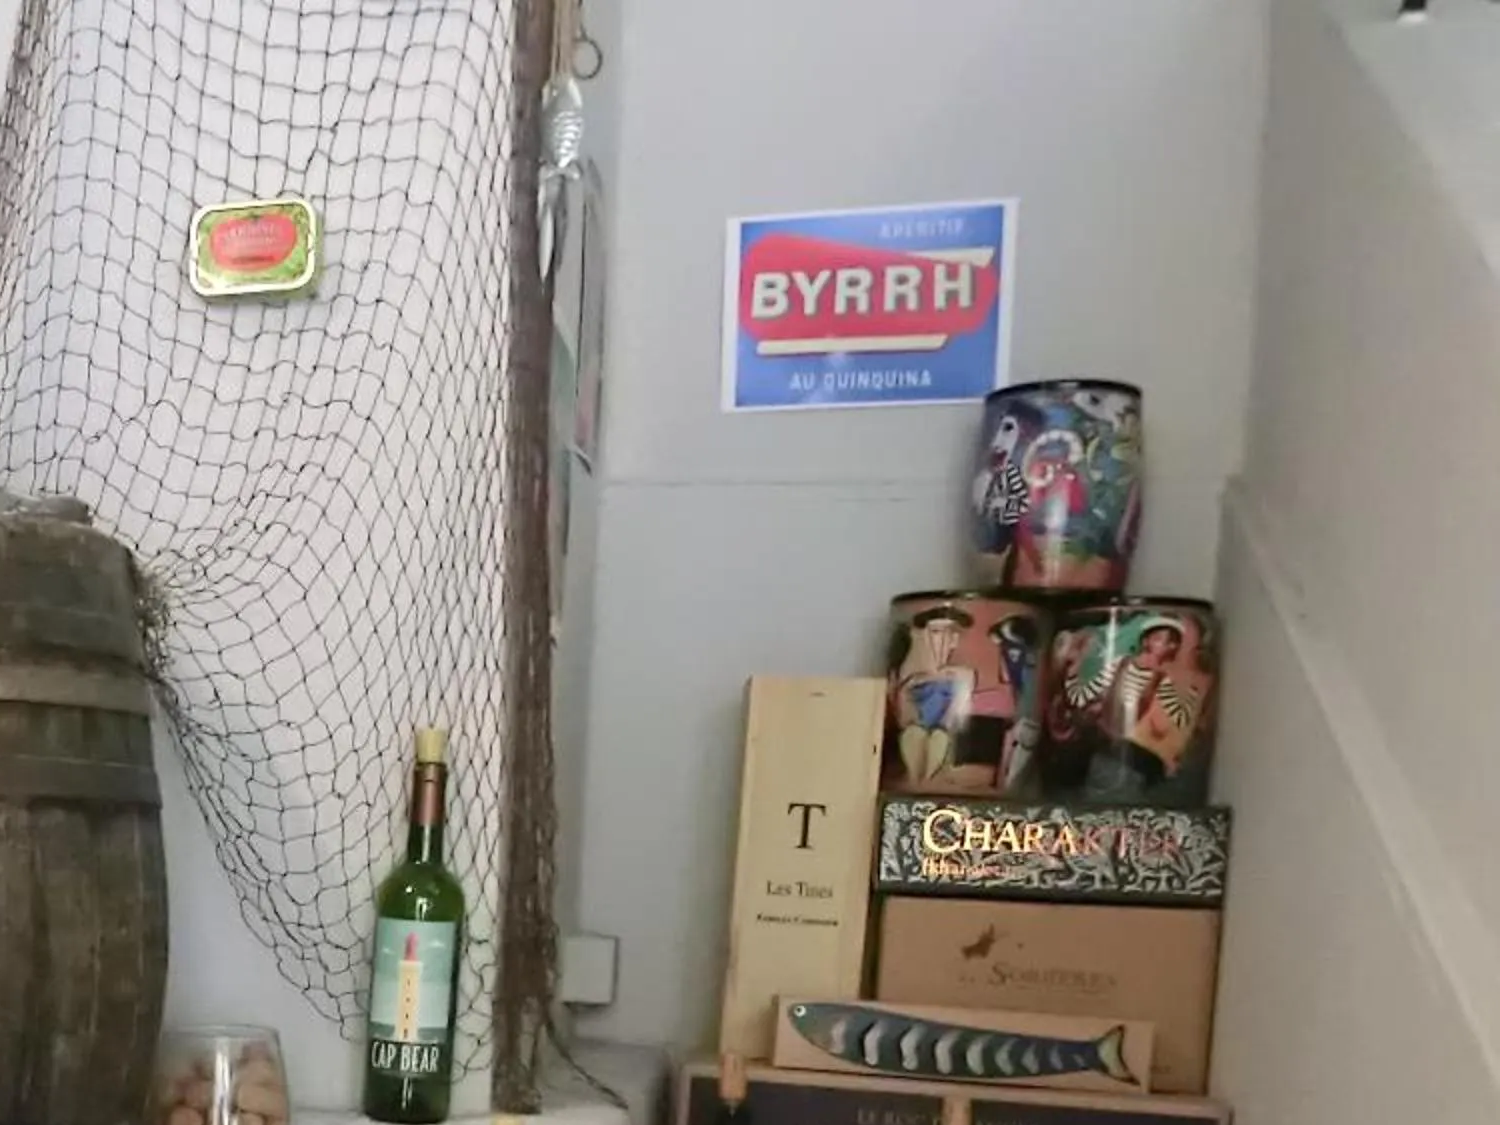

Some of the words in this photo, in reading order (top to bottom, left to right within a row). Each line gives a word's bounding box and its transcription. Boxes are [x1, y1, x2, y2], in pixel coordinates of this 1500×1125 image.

[751, 263, 974, 318] BYRRH
[789, 371, 815, 391] AU
[823, 368, 932, 392] QUINQUINA
[787, 802, 827, 850] T
[371, 1041, 397, 1069] CAP
